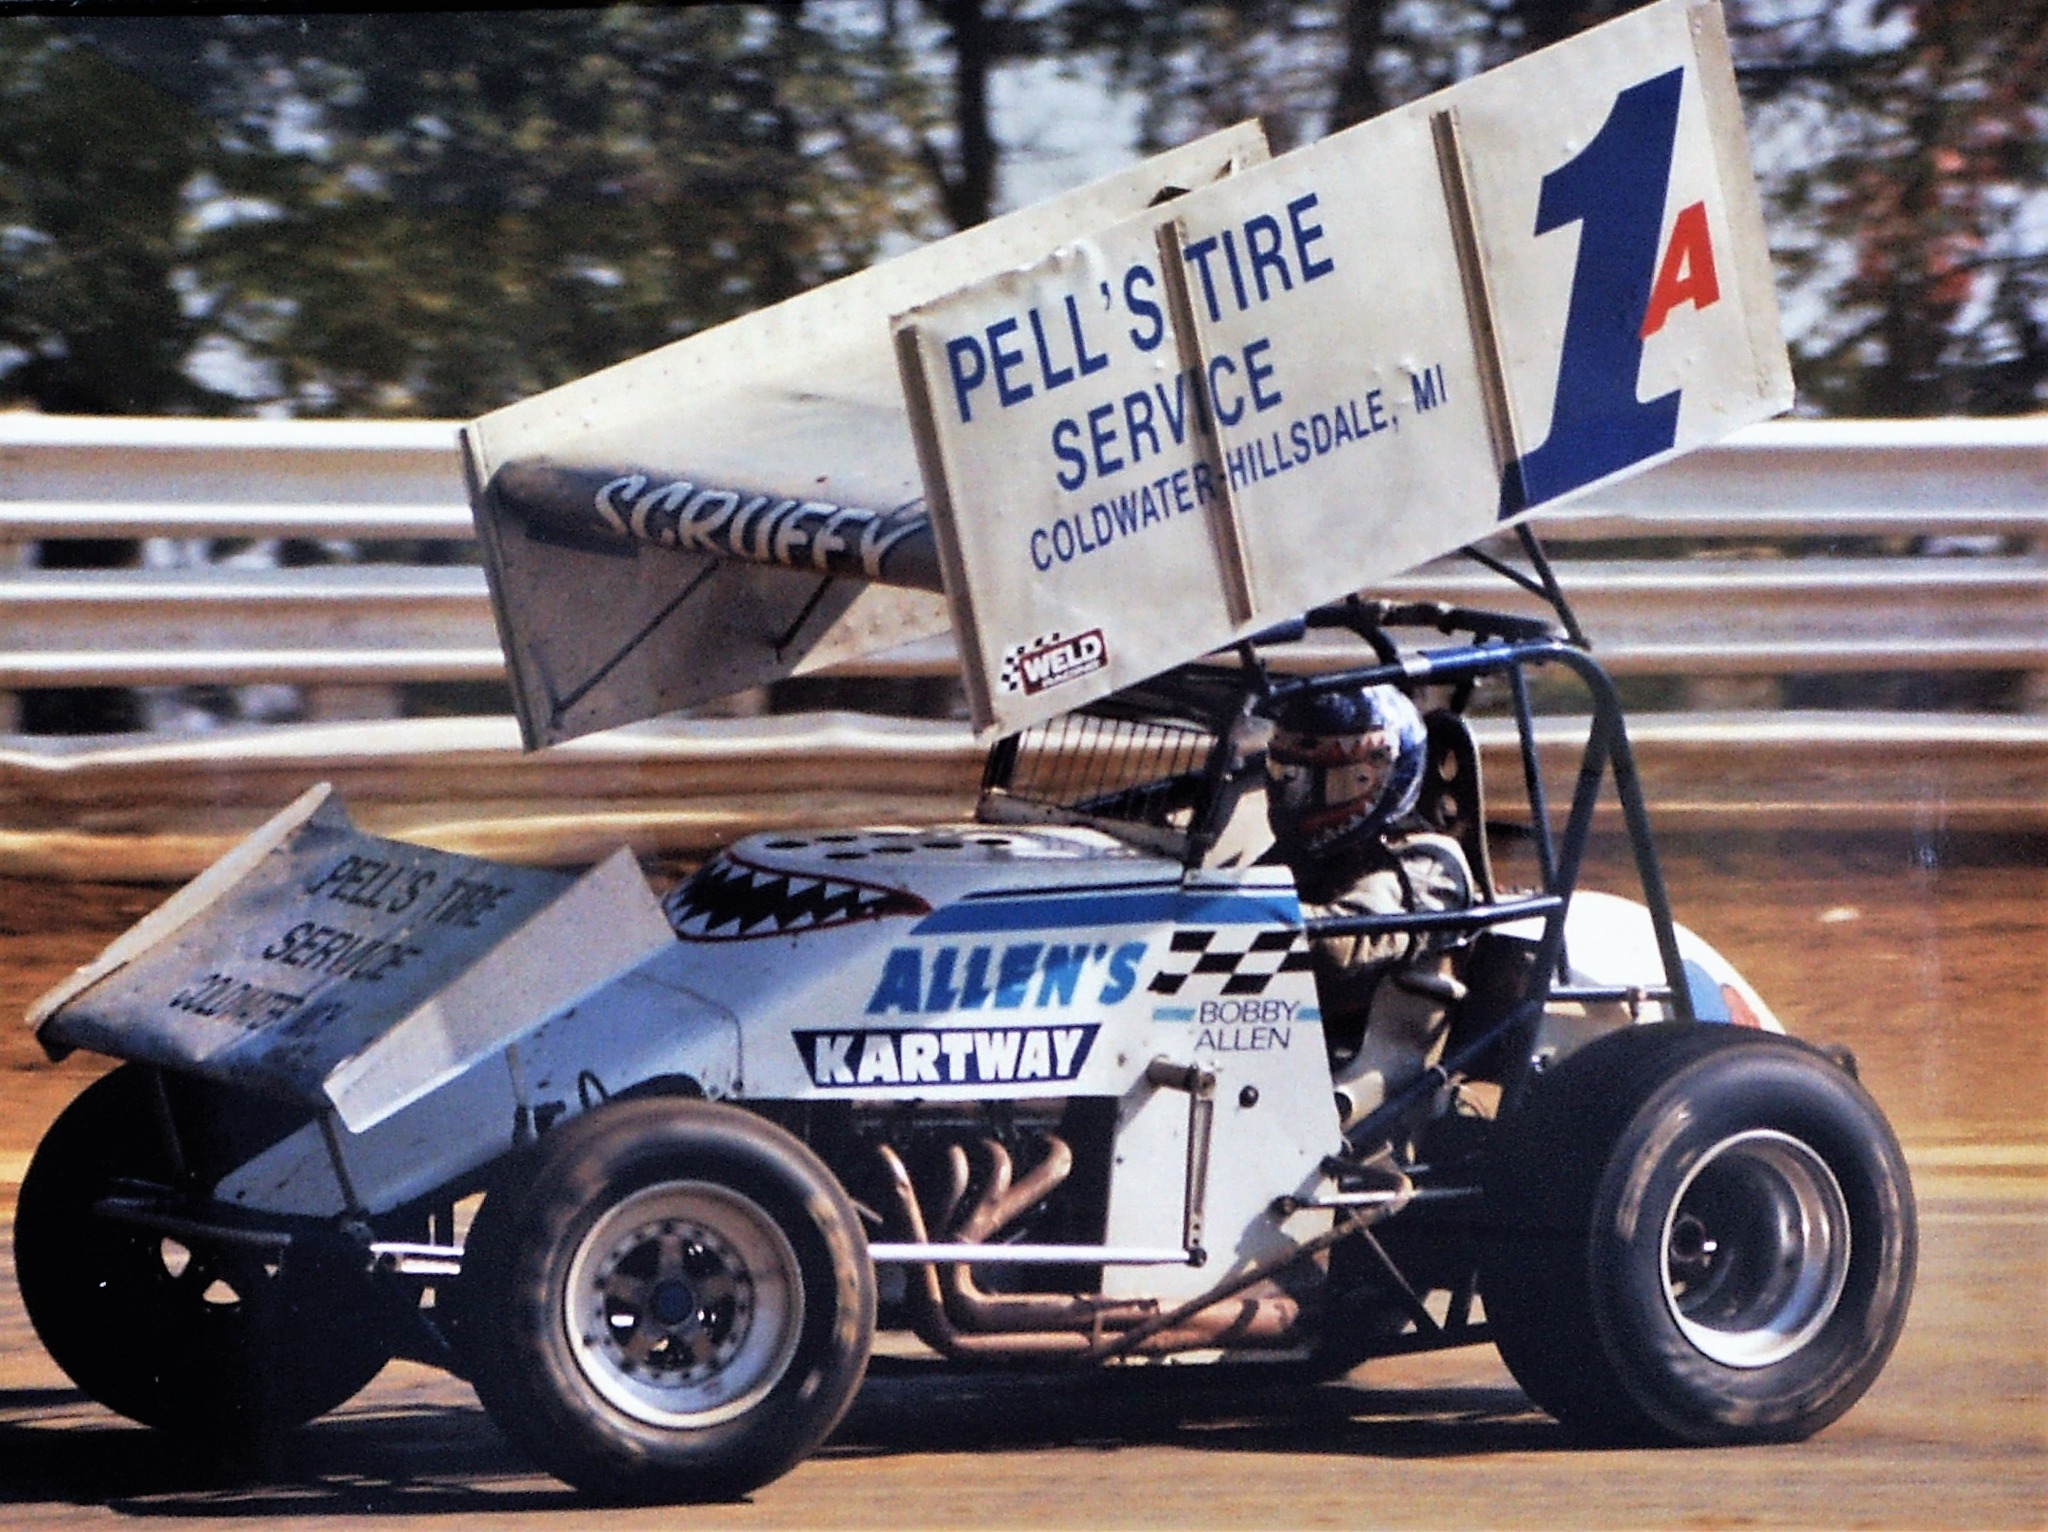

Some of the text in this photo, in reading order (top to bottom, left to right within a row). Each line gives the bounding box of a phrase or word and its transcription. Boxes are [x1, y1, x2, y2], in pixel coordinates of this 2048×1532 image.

[946, 193, 1335, 423] PELL'S TIRE
[1051, 338, 1283, 491] SERVICE
[1410, 365, 1448, 414] MI
[1022, 635, 1101, 684] WELD
[866, 941, 1154, 1015] ALLEN'S
[1199, 1000, 1301, 1024] BOBBY
[814, 1028, 1085, 1085] KARTWAY
[1194, 1027, 1291, 1051] ALLEN
